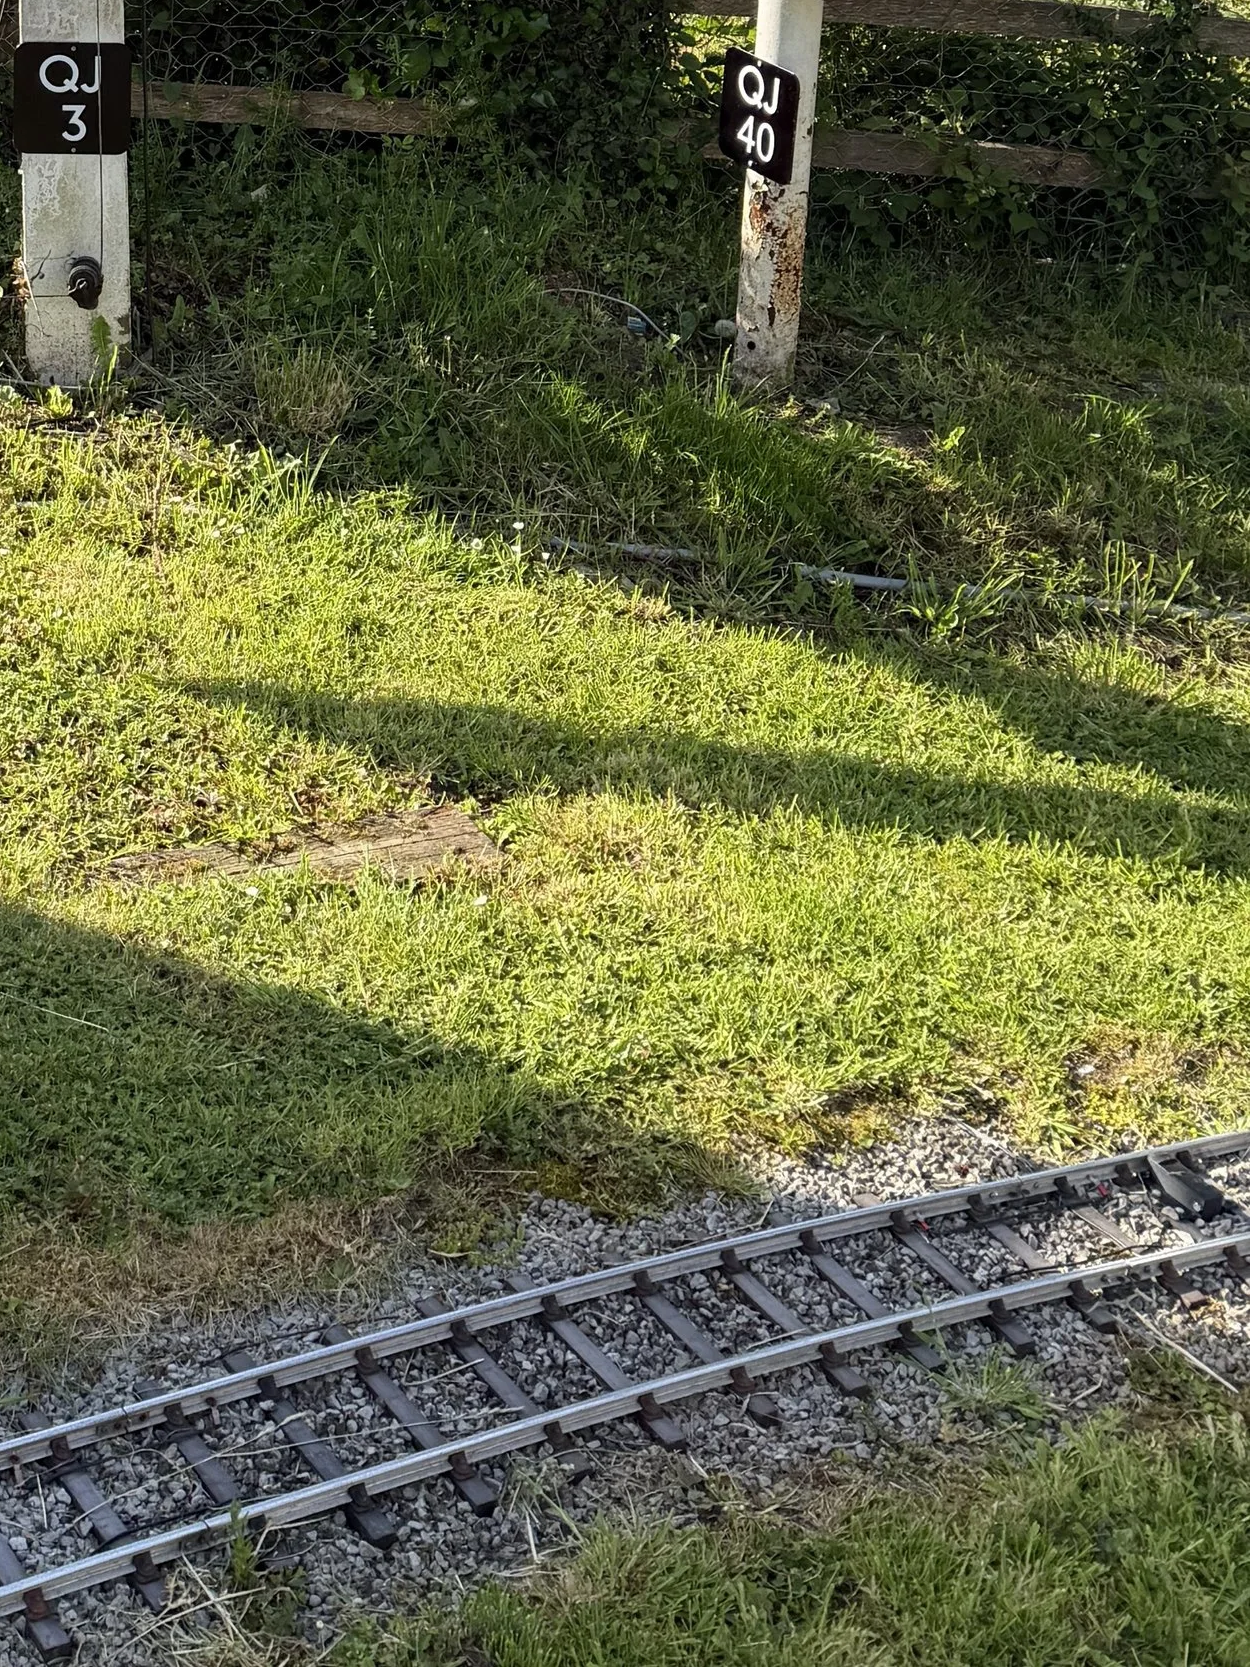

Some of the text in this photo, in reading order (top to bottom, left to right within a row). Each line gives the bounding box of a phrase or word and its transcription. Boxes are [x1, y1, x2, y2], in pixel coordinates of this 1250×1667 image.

[39, 54, 101, 94] QJ
[738, 64, 781, 115] QJ
[61, 104, 87, 142] 3
[736, 115, 775, 163] 40
